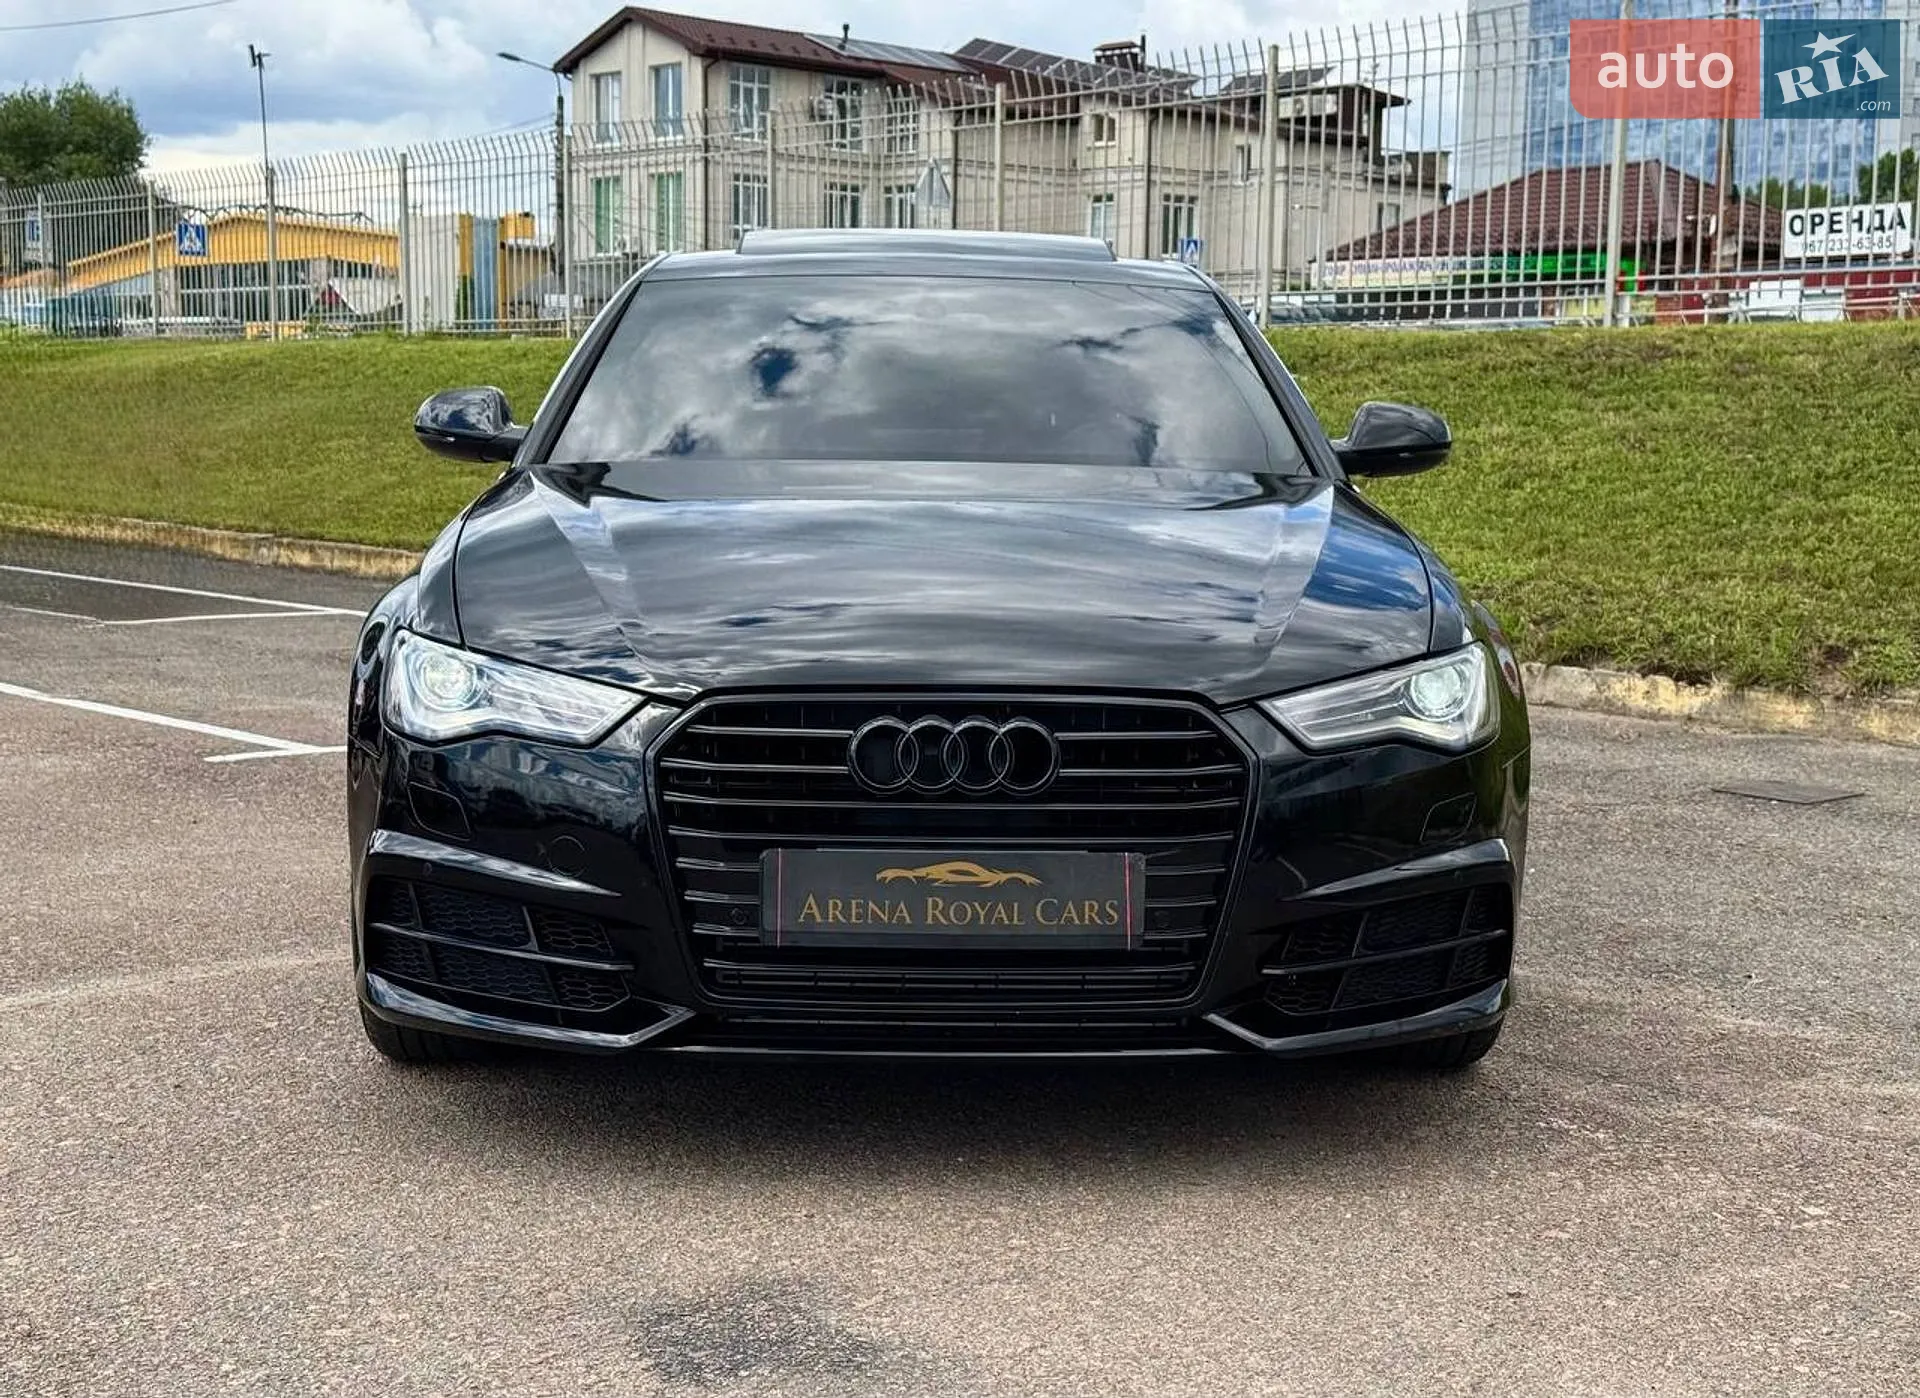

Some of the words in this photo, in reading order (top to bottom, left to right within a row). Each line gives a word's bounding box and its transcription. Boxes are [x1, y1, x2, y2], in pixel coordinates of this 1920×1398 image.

[1789, 208, 1907, 236] ОРЕНДА
[798, 893, 913, 924] ARENA
[925, 896, 1025, 925] ROYAL
[1035, 897, 1120, 926] CARS
